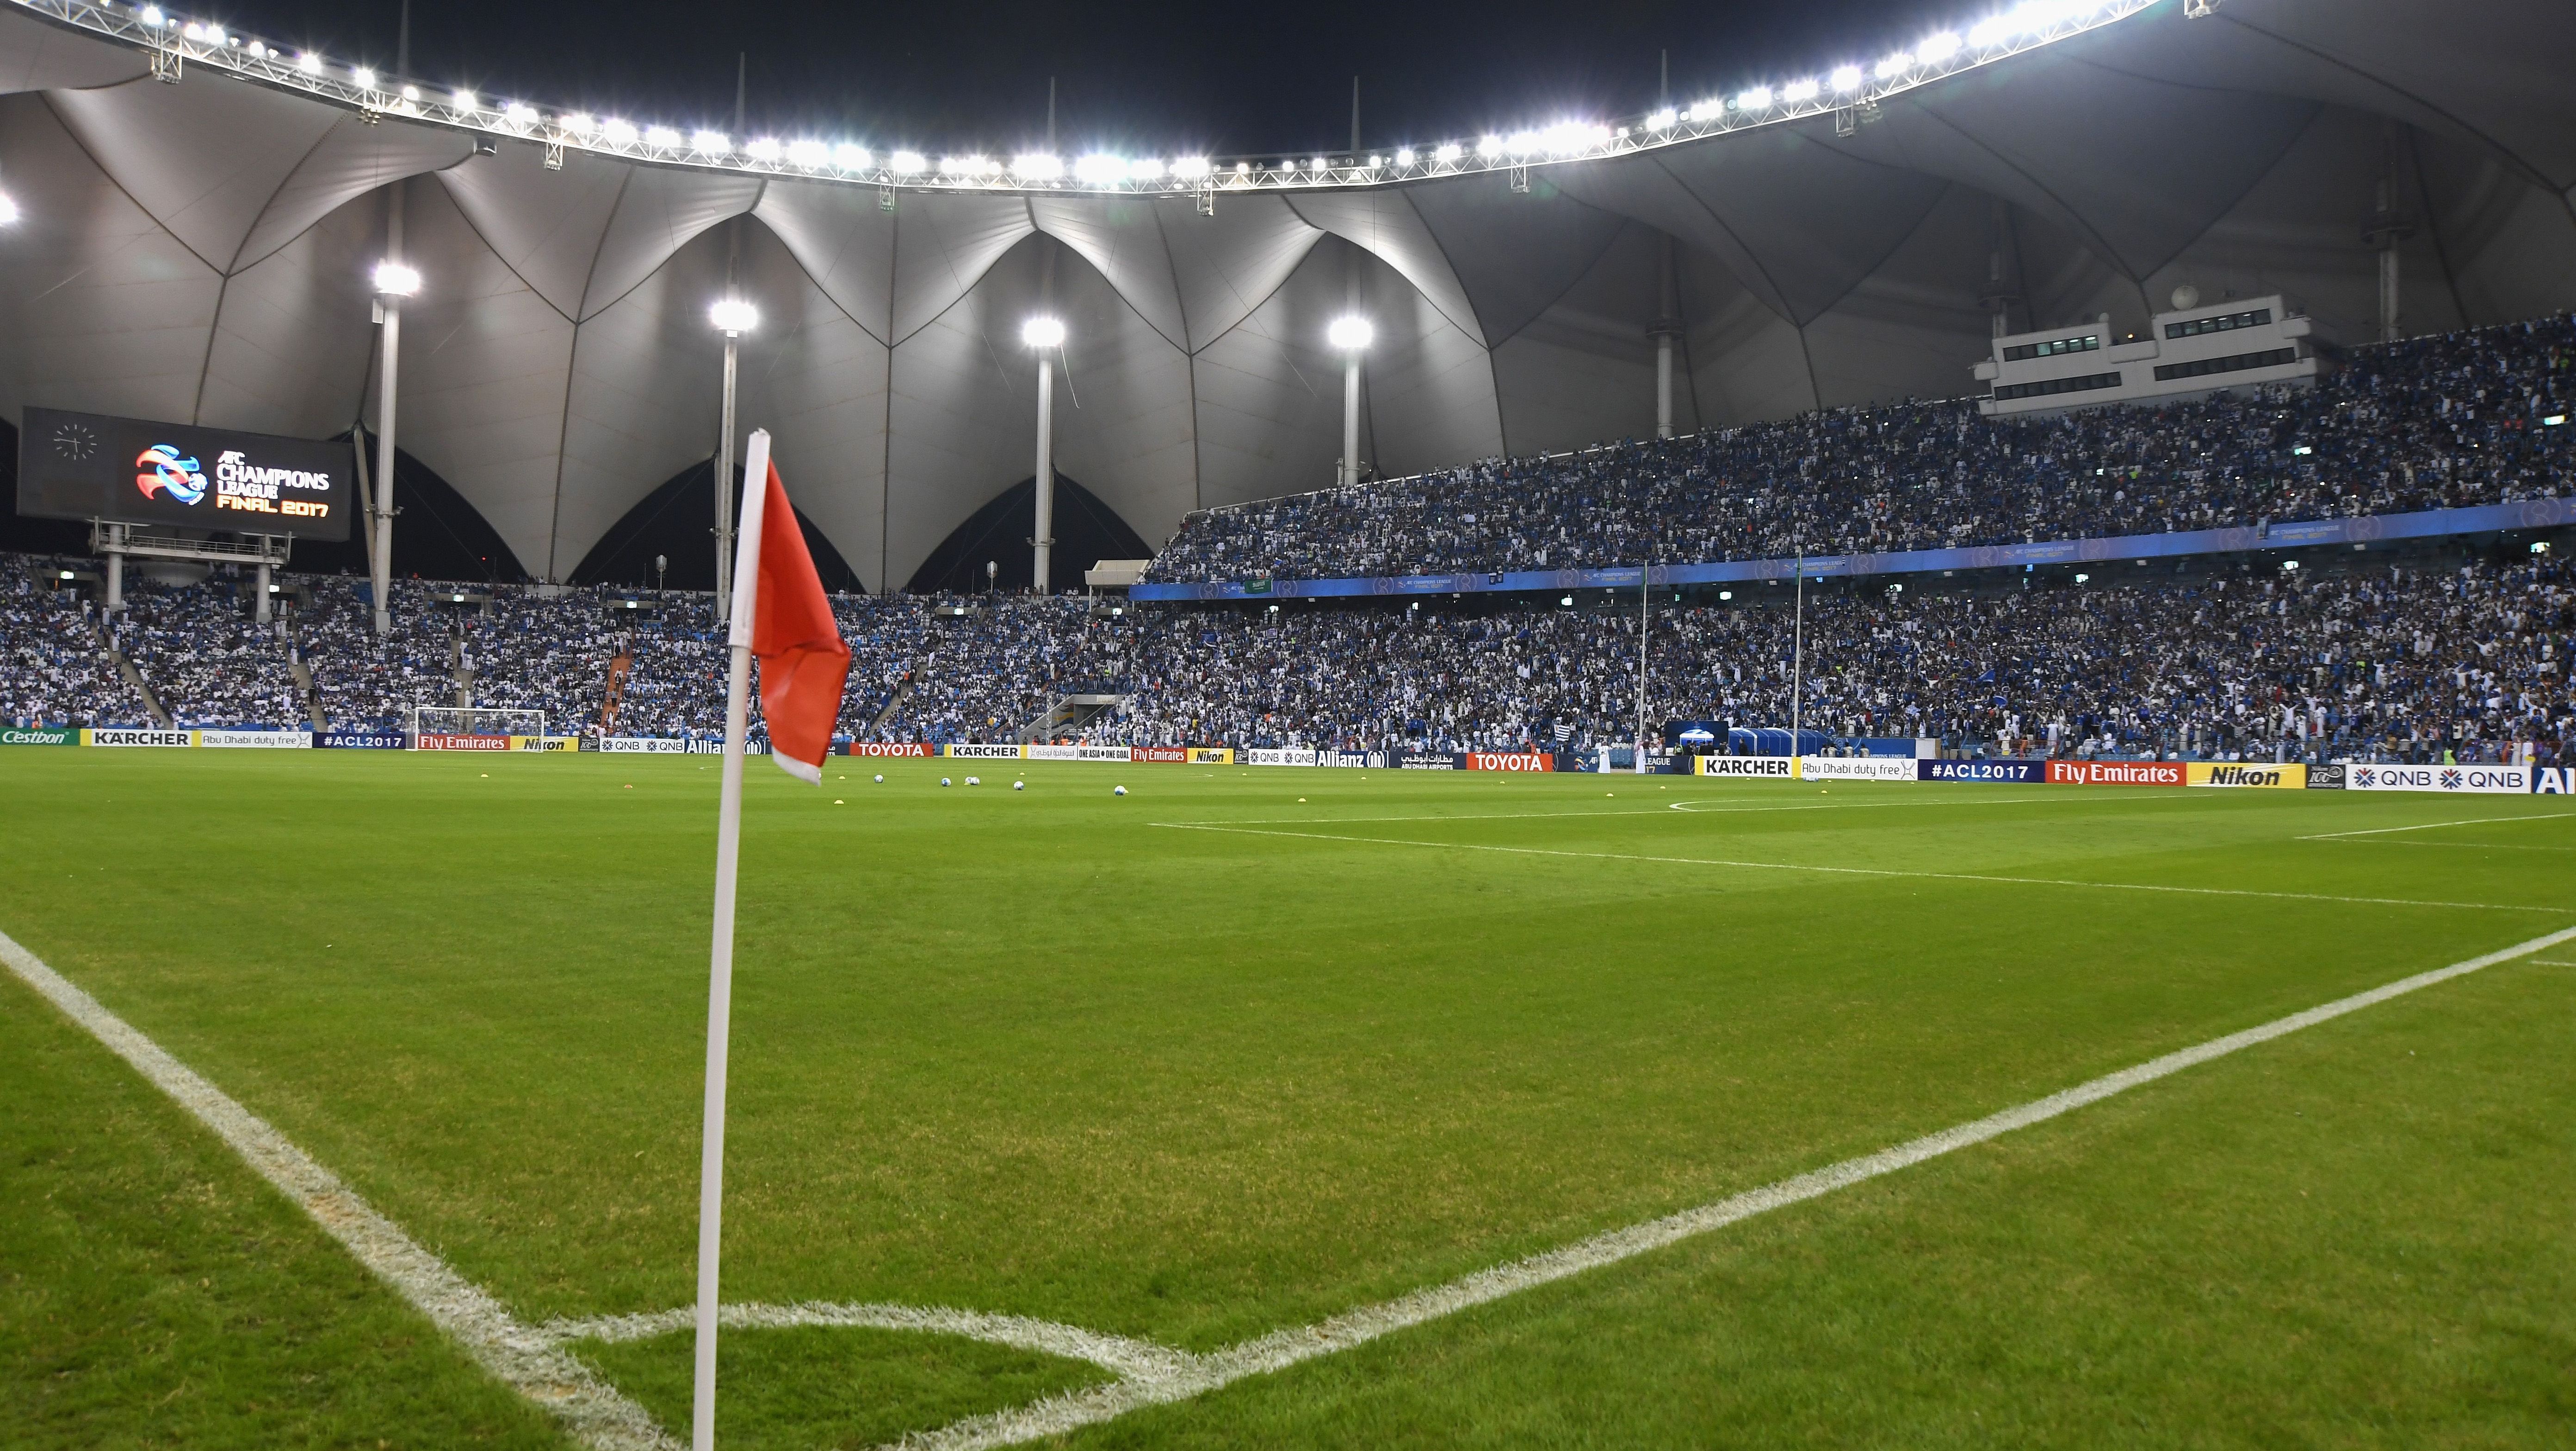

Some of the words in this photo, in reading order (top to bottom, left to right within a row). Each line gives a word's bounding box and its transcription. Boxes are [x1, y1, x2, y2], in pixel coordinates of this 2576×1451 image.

[218, 451, 245, 465] AFC
[217, 463, 329, 490] CHAMPIONS
[217, 480, 278, 499] LEAGUE
[217, 494, 278, 513] FINAL
[281, 500, 328, 517] 2017
[95, 732, 189, 745] KÄRCHER
[203, 735, 221, 744] Abu
[225, 736, 251, 744] Dhabi
[254, 737, 275, 746] duty
[324, 736, 402, 747] #ACL2017
[421, 736, 444, 750] Fly
[447, 736, 505, 749] Emirates
[615, 740, 640, 750] QNB
[659, 741, 683, 751] QNB
[686, 739, 726, 754] Allia
[859, 744, 924, 757] TOYOTA
[954, 746, 1018, 757] KÄRCHER
[1079, 749, 1088, 758] ONE
[1089, 750, 1100, 758] ASIA
[1106, 750, 1115, 759] ONE
[1116, 750, 1129, 759] GOAL
[1134, 749, 1147, 763] Fly
[1149, 749, 1184, 762] Emirates
[1196, 750, 1224, 763] Nikon
[1260, 753, 1279, 763] QNB
[1294, 754, 1314, 764] QNB
[1317, 751, 1364, 768] Allianz
[1475, 754, 1543, 771] TOYOTA
[1706, 760, 1789, 775] KÄRCHER
[1802, 763, 1821, 772] Abu
[1823, 764, 1851, 774] Dhabi
[1854, 764, 1876, 776] duty
[1879, 764, 1900, 775] free
[1931, 764, 2029, 779] #ACL2017
[2054, 763, 2087, 784] Fly
[2089, 764, 2179, 783] Emirates
[2210, 766, 2279, 786] Nikon
[2381, 770, 2431, 786] QNB
[2468, 771, 2523, 788] QNB
